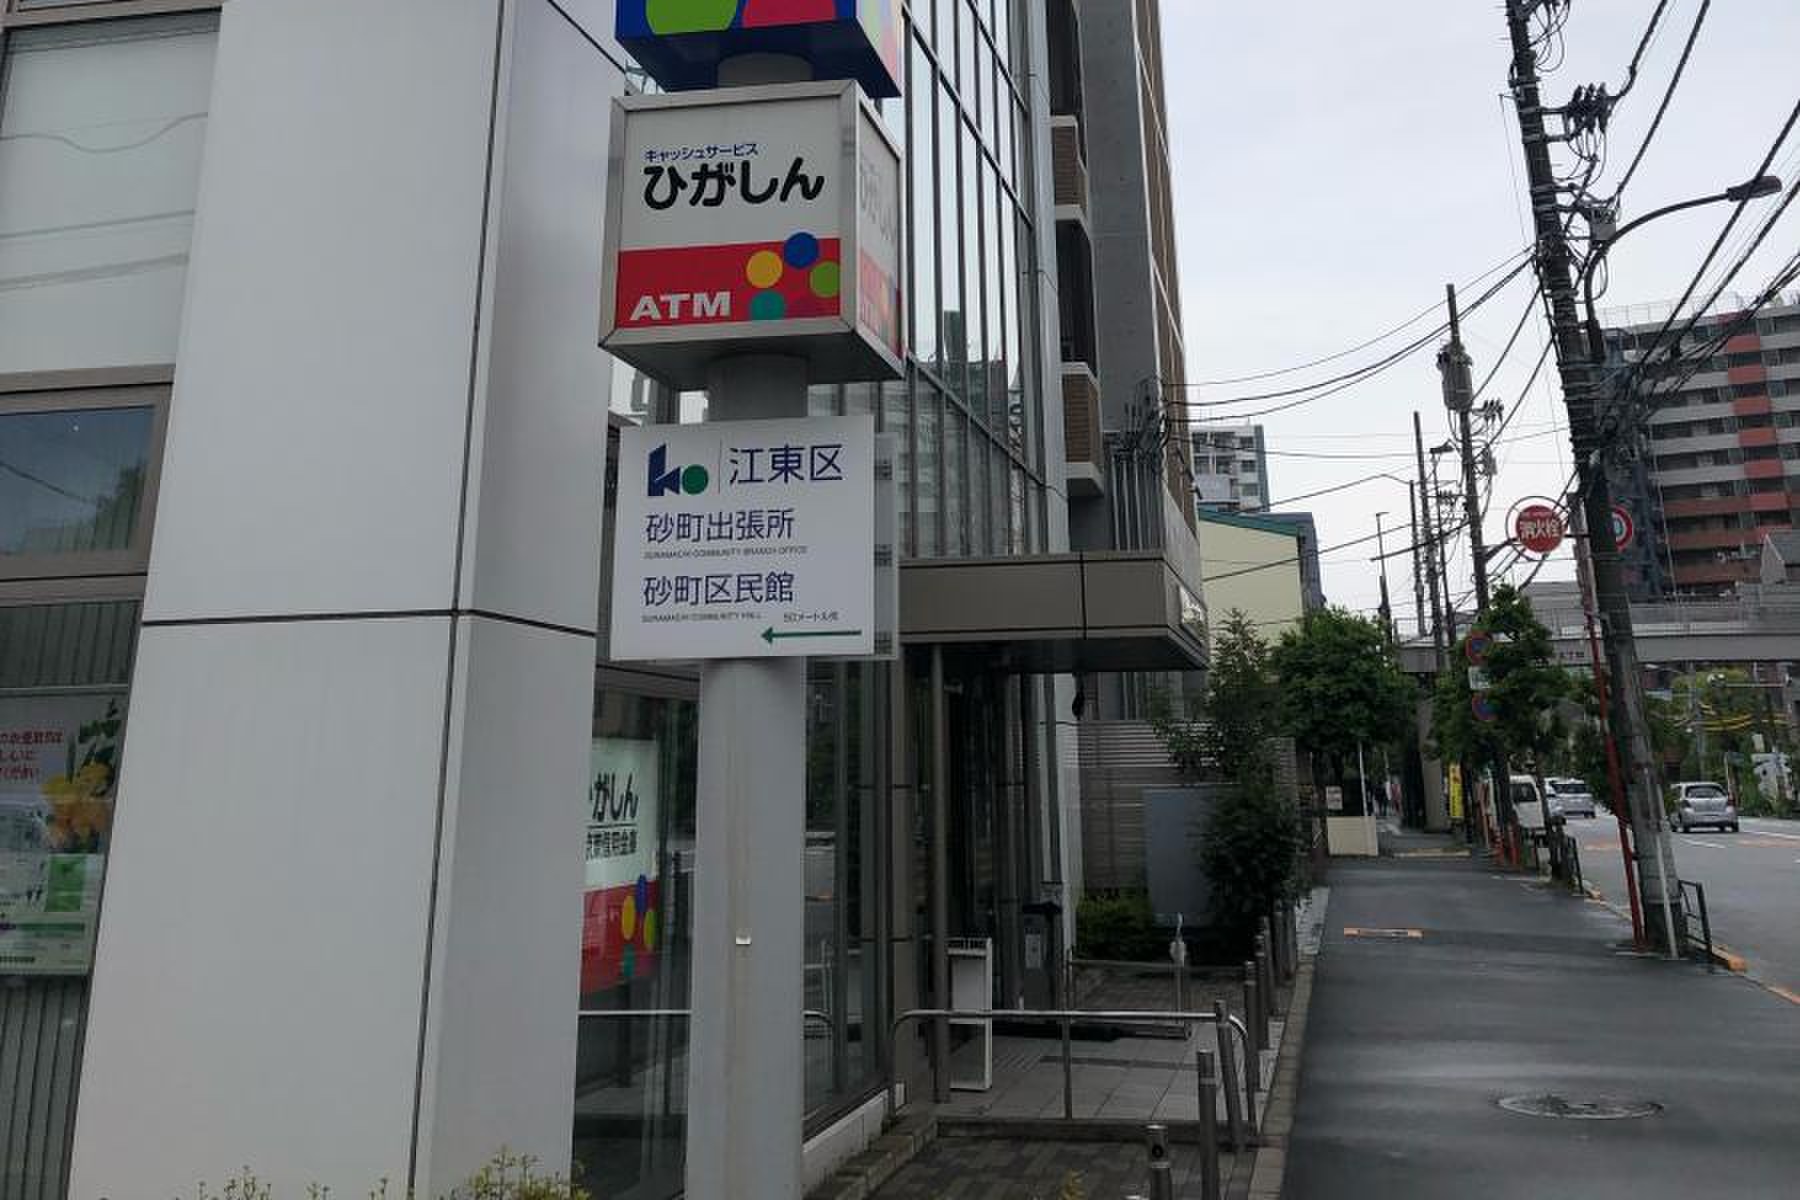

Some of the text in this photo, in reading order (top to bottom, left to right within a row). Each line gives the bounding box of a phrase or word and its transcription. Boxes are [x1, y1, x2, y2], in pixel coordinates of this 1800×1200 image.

[645, 143, 758, 162] キャッシュサービス
[643, 157, 825, 210] ひがしん
[630, 291, 731, 320] ATM
[729, 443, 843, 485] 江東区
[646, 508, 795, 543] 砂町出張所
[643, 572, 795, 606] 砂町区民館
[588, 773, 639, 821] がしん
